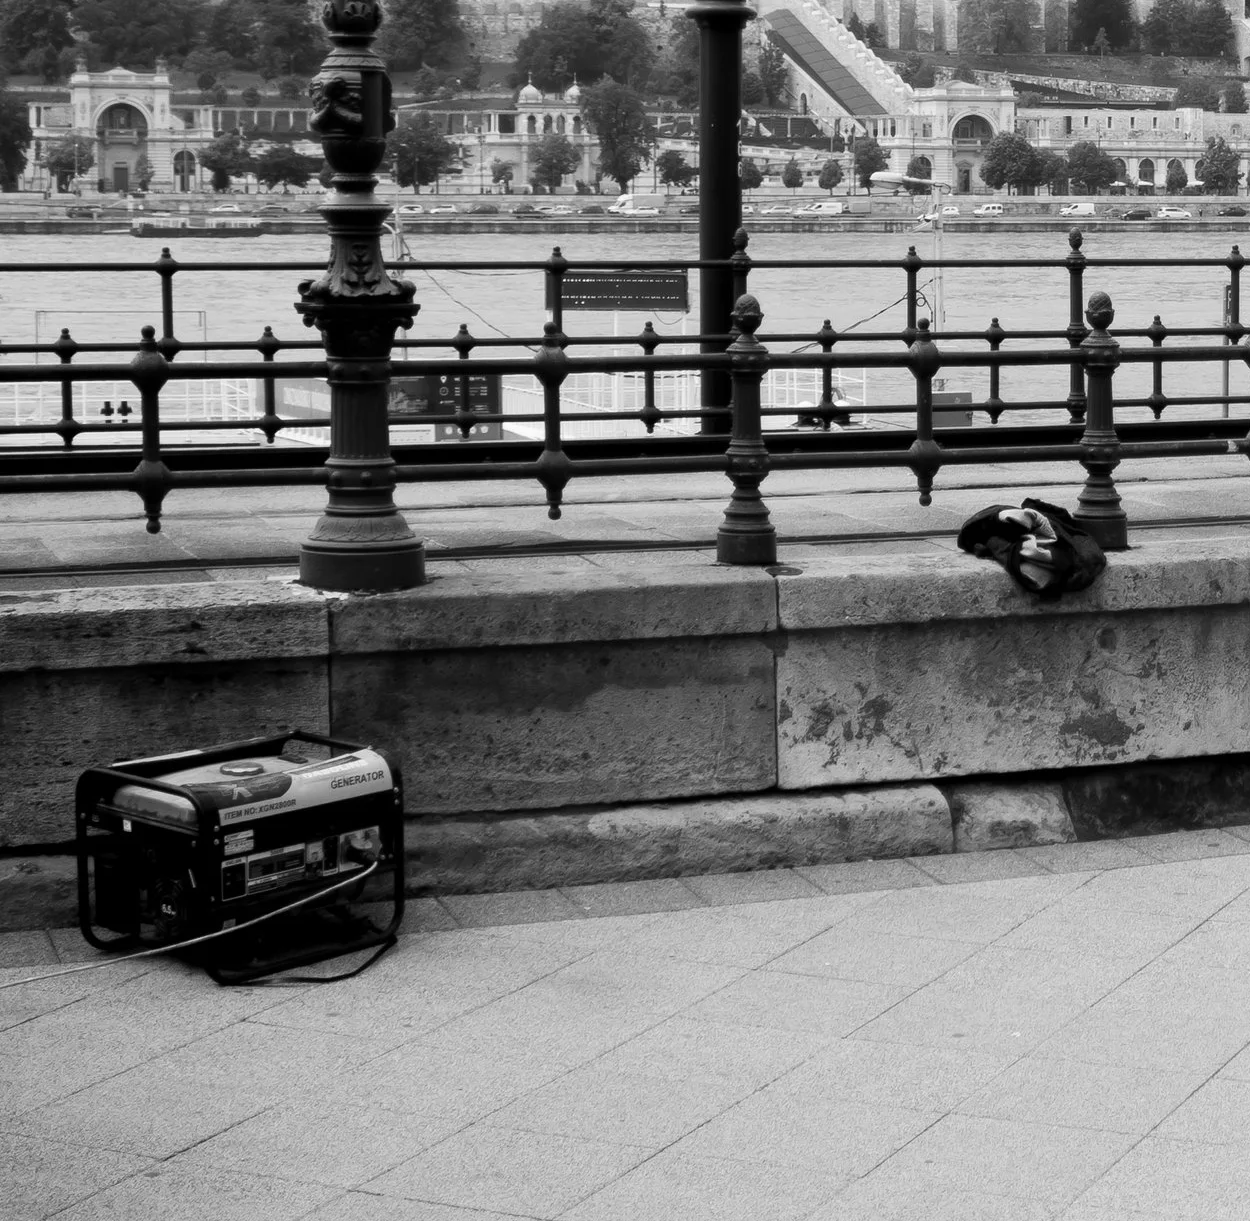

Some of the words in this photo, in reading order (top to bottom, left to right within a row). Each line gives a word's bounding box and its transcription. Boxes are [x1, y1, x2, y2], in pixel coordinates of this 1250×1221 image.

[330, 770, 384, 790] GENERATOR
[223, 811, 243, 821] ITEM
[244, 807, 258, 817] NO:
